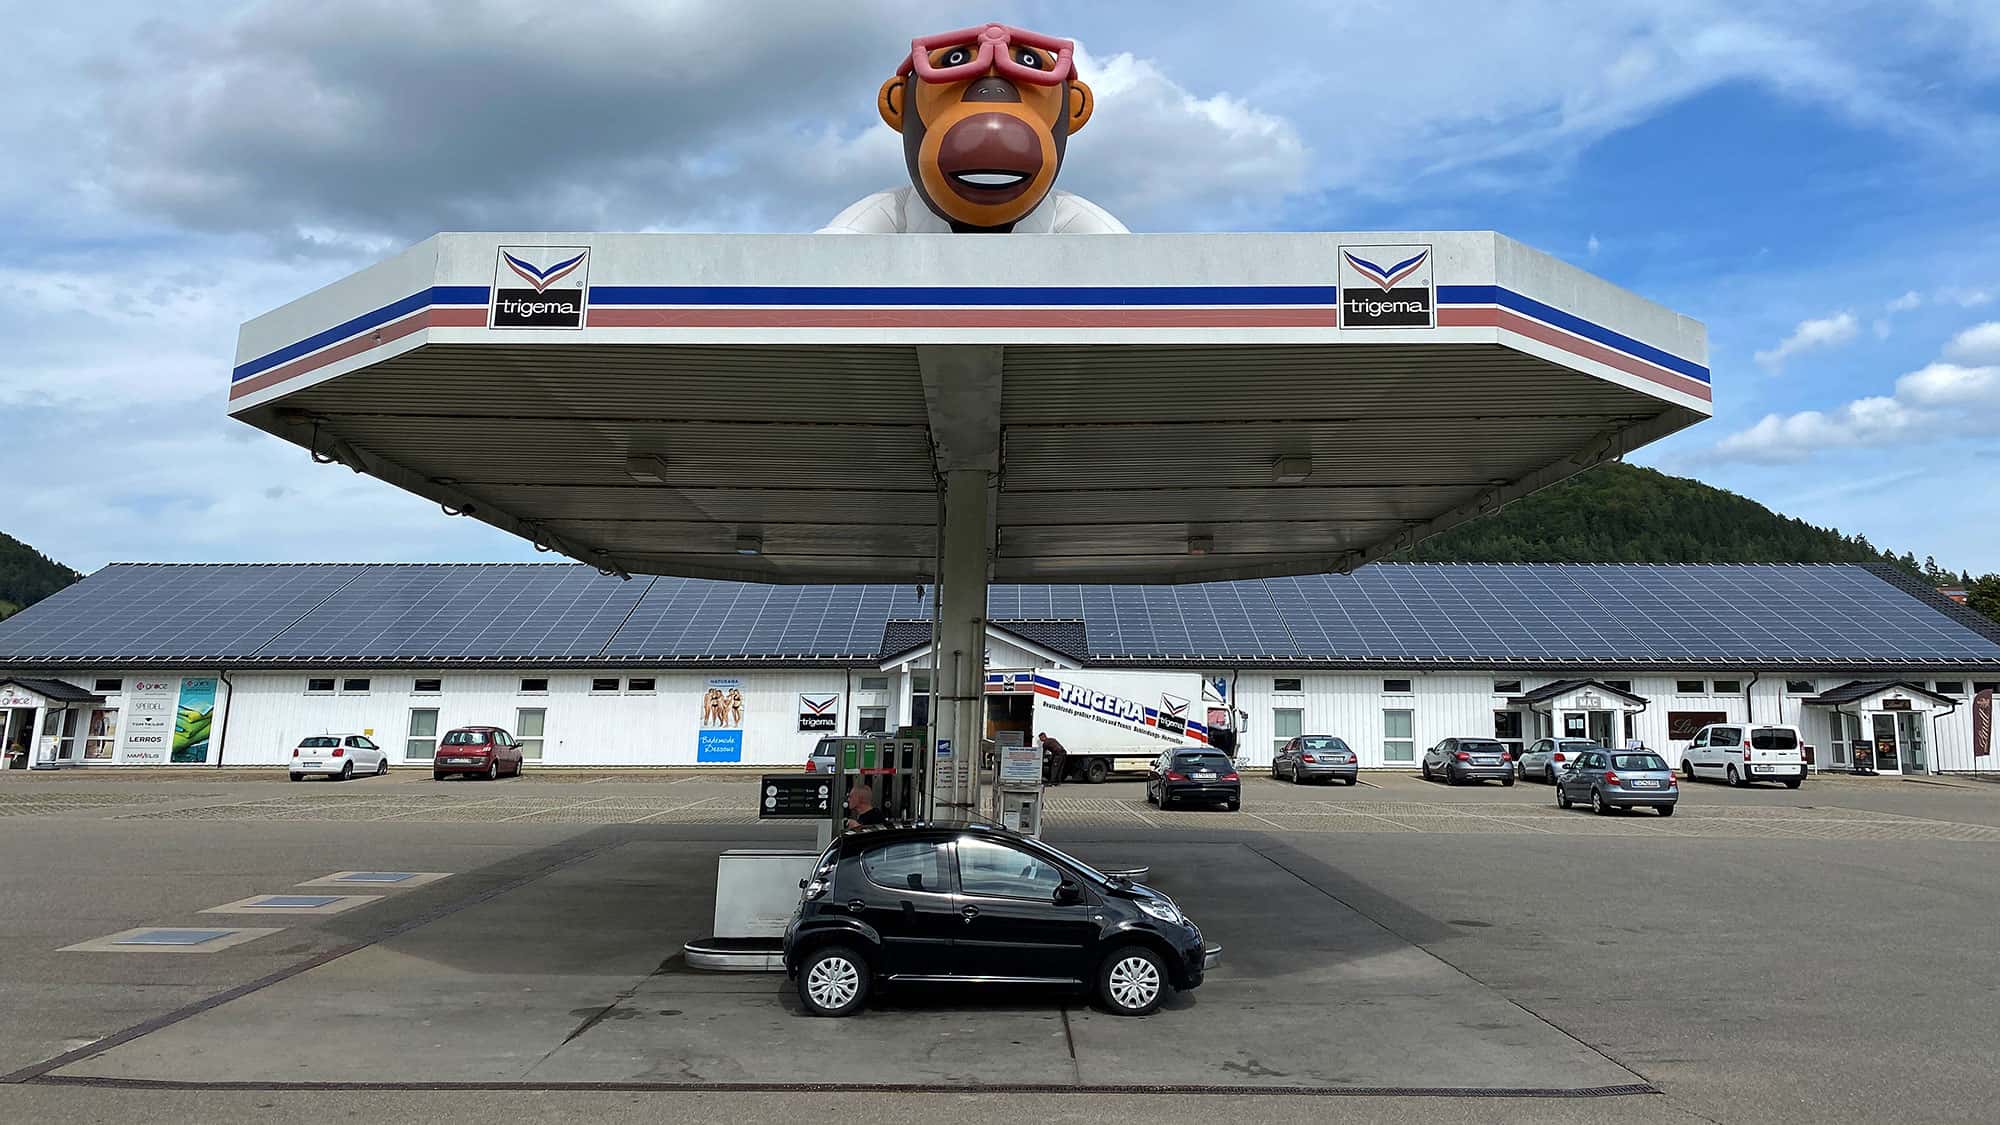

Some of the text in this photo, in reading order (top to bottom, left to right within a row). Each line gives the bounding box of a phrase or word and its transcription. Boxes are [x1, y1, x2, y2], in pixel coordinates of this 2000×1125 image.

[499, 298, 578, 317] trigema
[1348, 298, 1427, 317] trigema
[1060, 681, 1145, 726] TRIGEMA
[801, 717, 836, 728] trigema
[818, 800, 827, 810] 4
